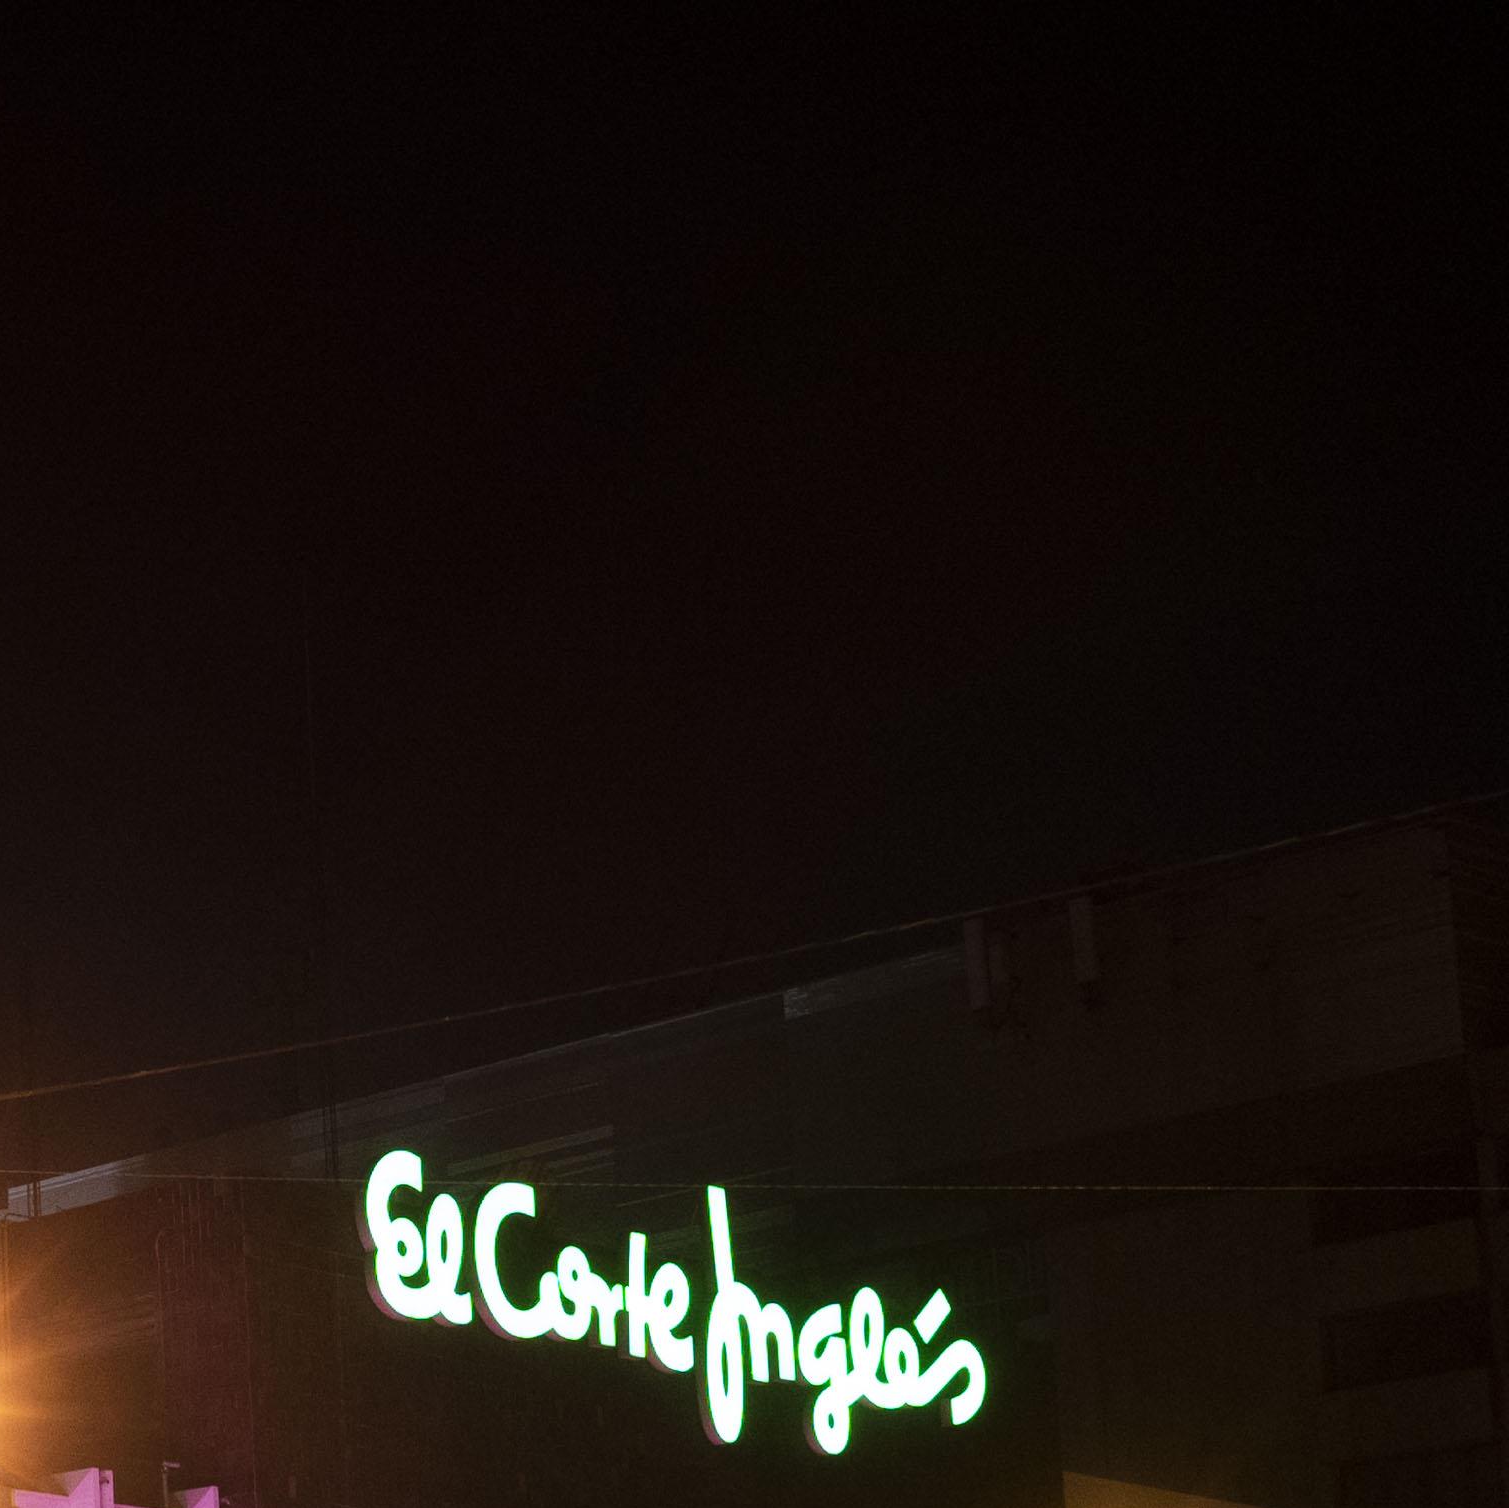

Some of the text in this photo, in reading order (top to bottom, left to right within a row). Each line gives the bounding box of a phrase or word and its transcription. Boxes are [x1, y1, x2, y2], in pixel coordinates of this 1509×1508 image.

[366, 1150, 986, 1455] El Corte Inglés
